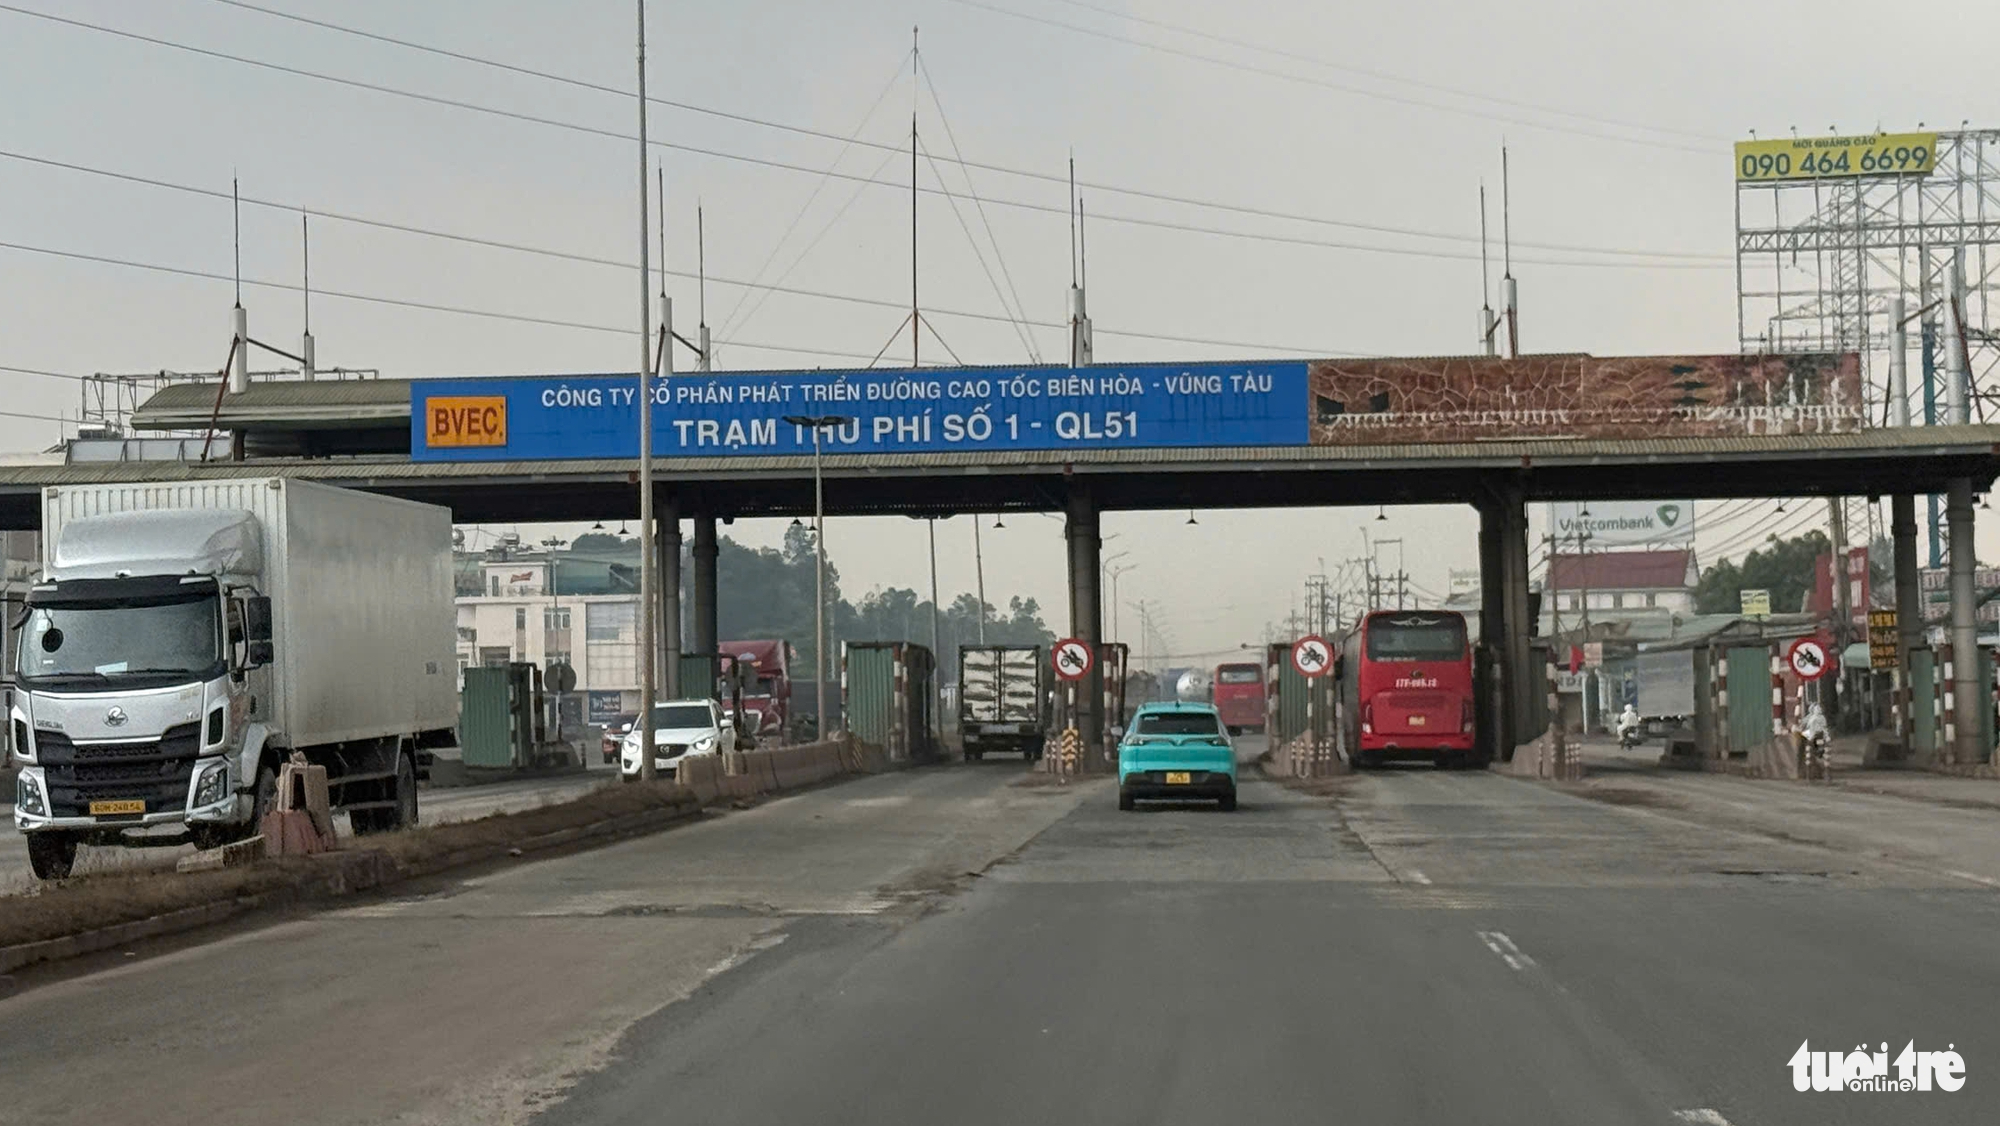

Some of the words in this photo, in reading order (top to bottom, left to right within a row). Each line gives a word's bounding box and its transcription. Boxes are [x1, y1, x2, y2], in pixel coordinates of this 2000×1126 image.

[1741, 153, 1791, 178] 090
[1799, 149, 1851, 175] 464
[1860, 146, 1929, 172] 6699
[541, 384, 602, 407] CÔNG
[608, 388, 636, 406] TY
[677, 380, 733, 404] PHẦN
[739, 381, 794, 403] PHÁT
[800, 375, 861, 401] TRIỂN
[866, 376, 942, 400] ĐƯỜNG
[947, 379, 991, 399] CAO
[997, 373, 1041, 398] TỐC
[1047, 375, 1095, 396] BIÊN
[1100, 372, 1144, 396] HÒA
[1164, 371, 1223, 395] VŨNG
[1229, 370, 1273, 393] TÀU
[434, 407, 498, 437] BVEC
[673, 418, 777, 450] TRẠM
[873, 407, 933, 443] PHÍ
[942, 403, 992, 442] SỐ
[1004, 413, 1018, 441] 1
[1055, 410, 1138, 440] QL51
[1559, 515, 1654, 532] Vietcombank
